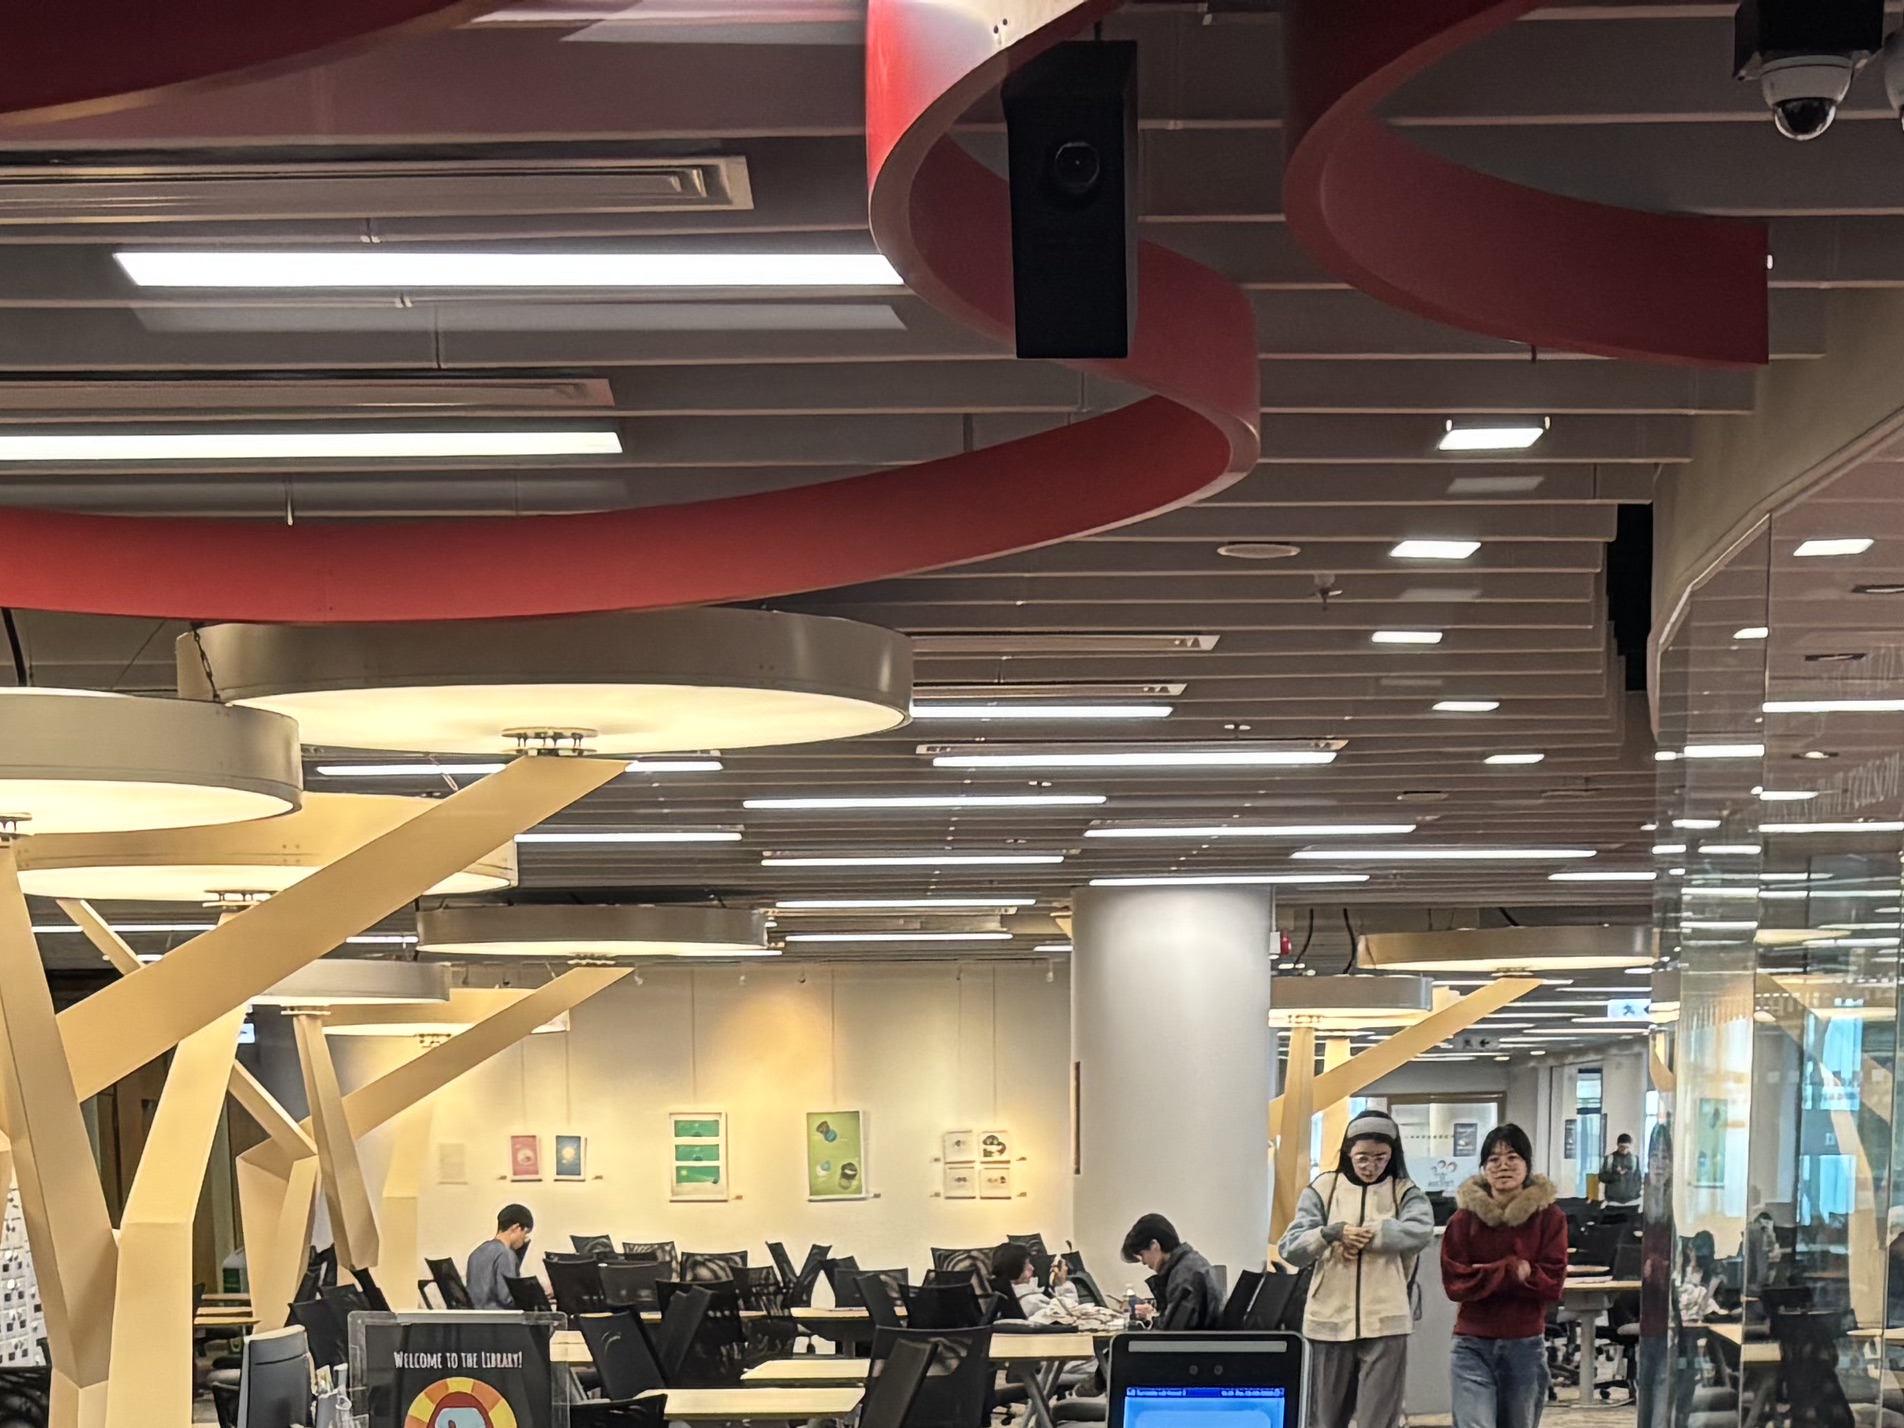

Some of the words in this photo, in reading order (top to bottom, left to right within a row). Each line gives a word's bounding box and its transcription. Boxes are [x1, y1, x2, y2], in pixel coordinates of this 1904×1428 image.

[394, 1351, 443, 1369] WELCOME
[446, 1352, 458, 1369] TO
[461, 1353, 478, 1369] THE
